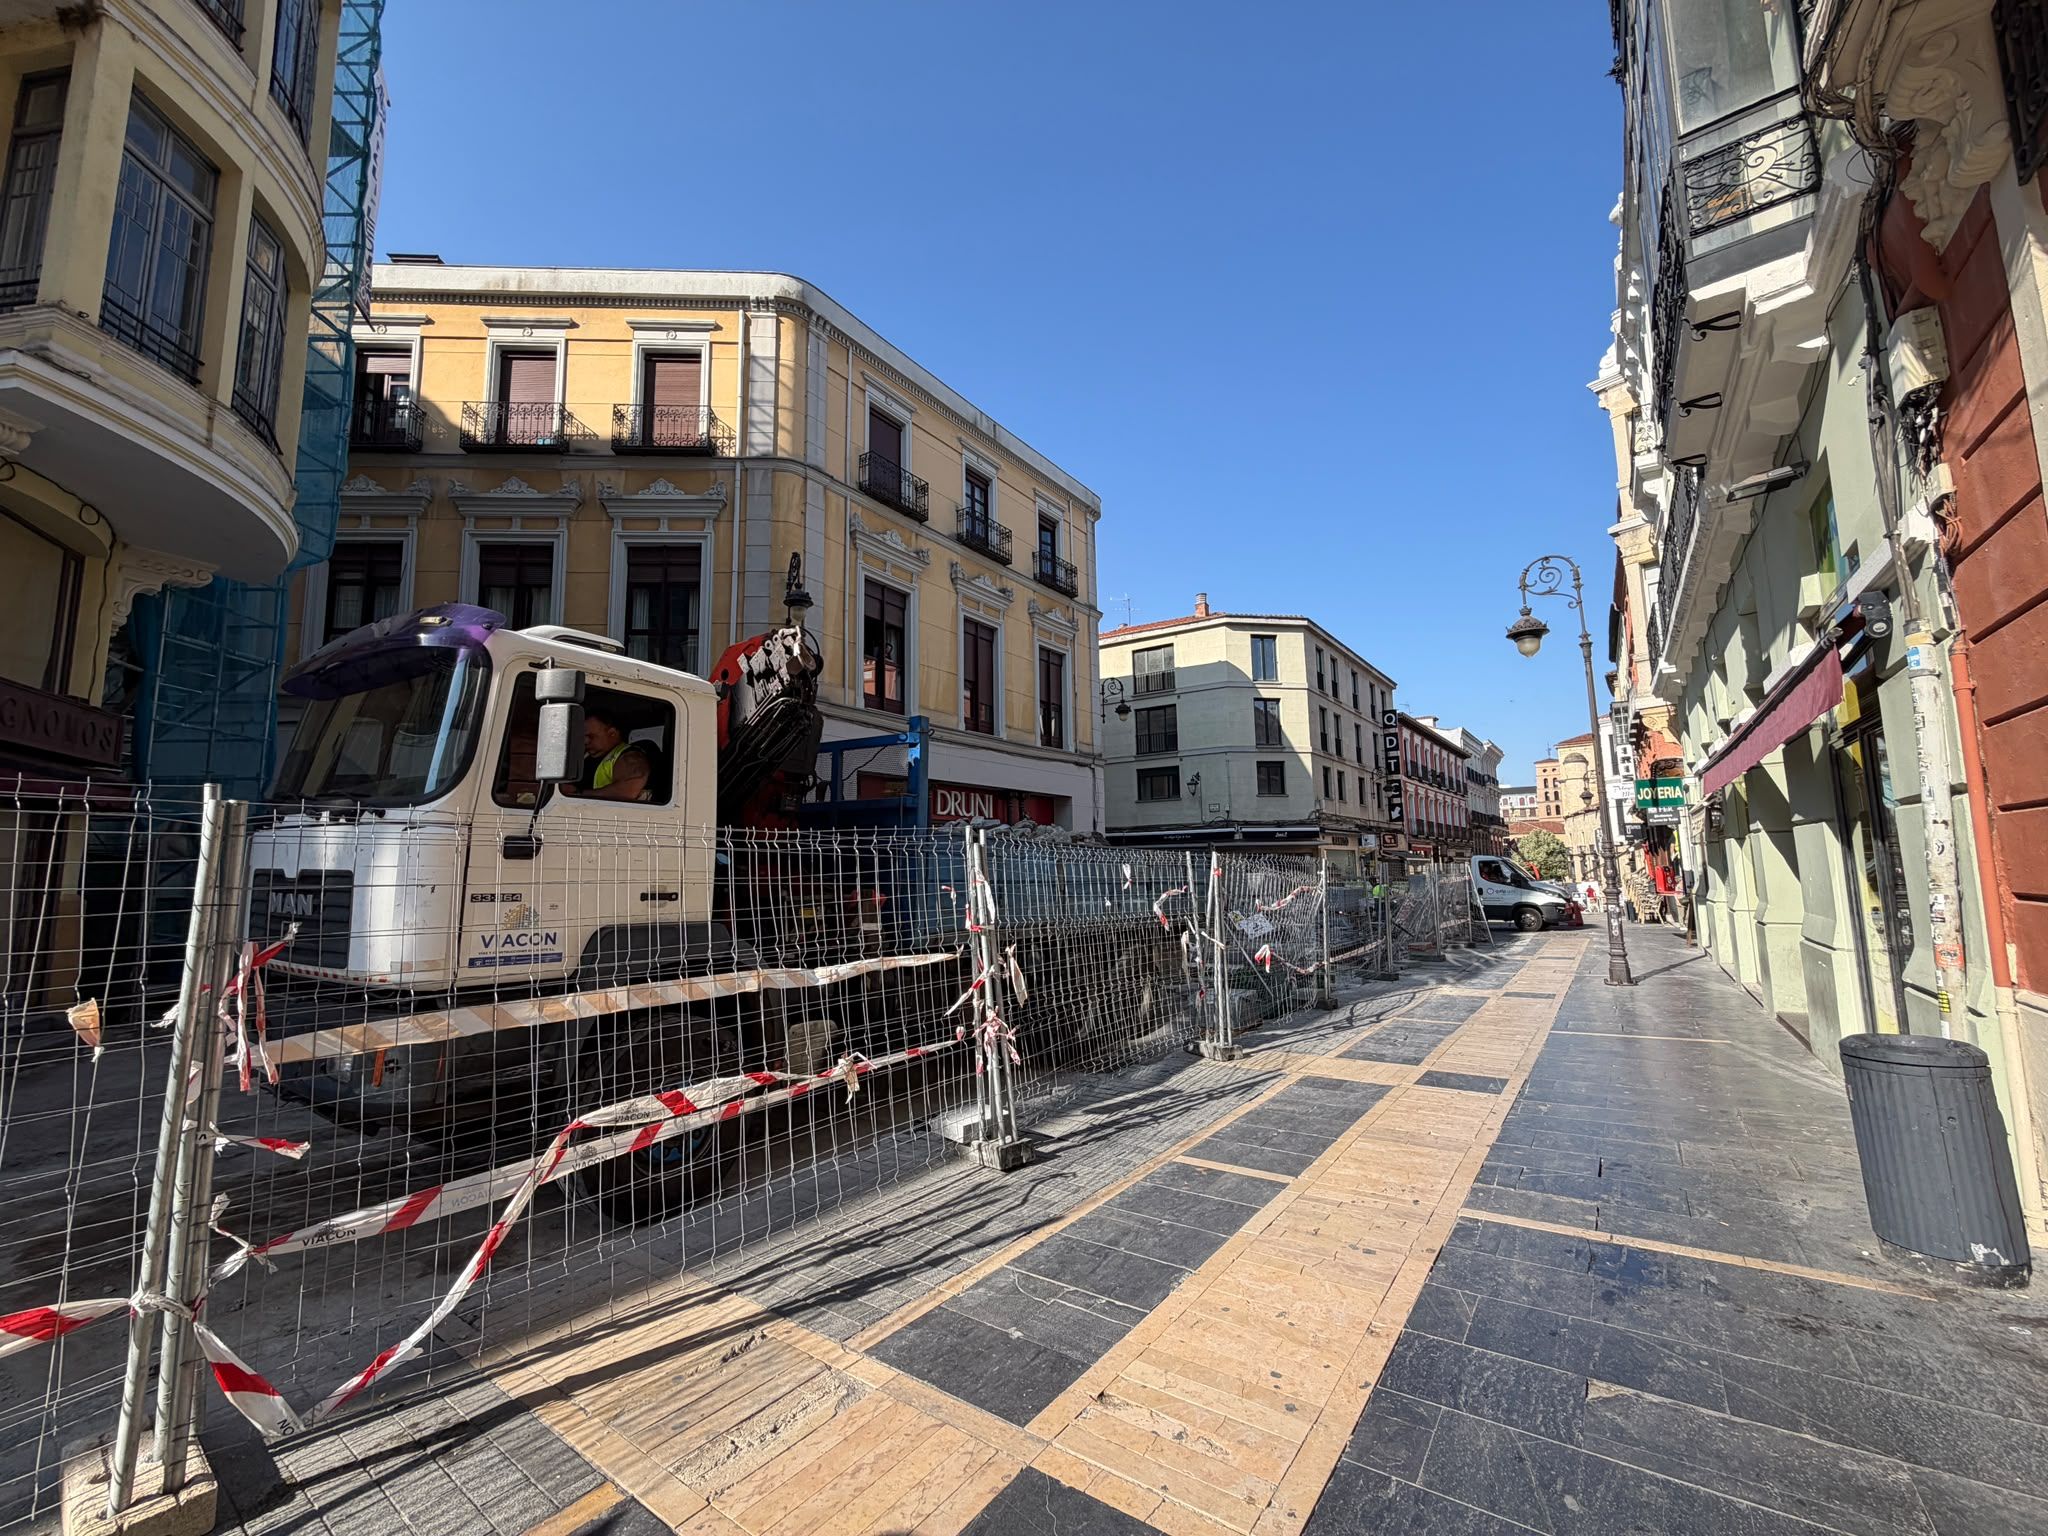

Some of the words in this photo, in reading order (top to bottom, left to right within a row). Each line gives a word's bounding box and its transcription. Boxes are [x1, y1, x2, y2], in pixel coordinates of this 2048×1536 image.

[1637, 786, 1683, 800] JOYERIA
[937, 789, 993, 818] DRUNI
[270, 891, 314, 916] MAN
[481, 932, 557, 949] VACON
[615, 1111, 650, 1124] VIACON
[572, 1154, 608, 1171] VIACON
[301, 1228, 357, 1247] VIACON
